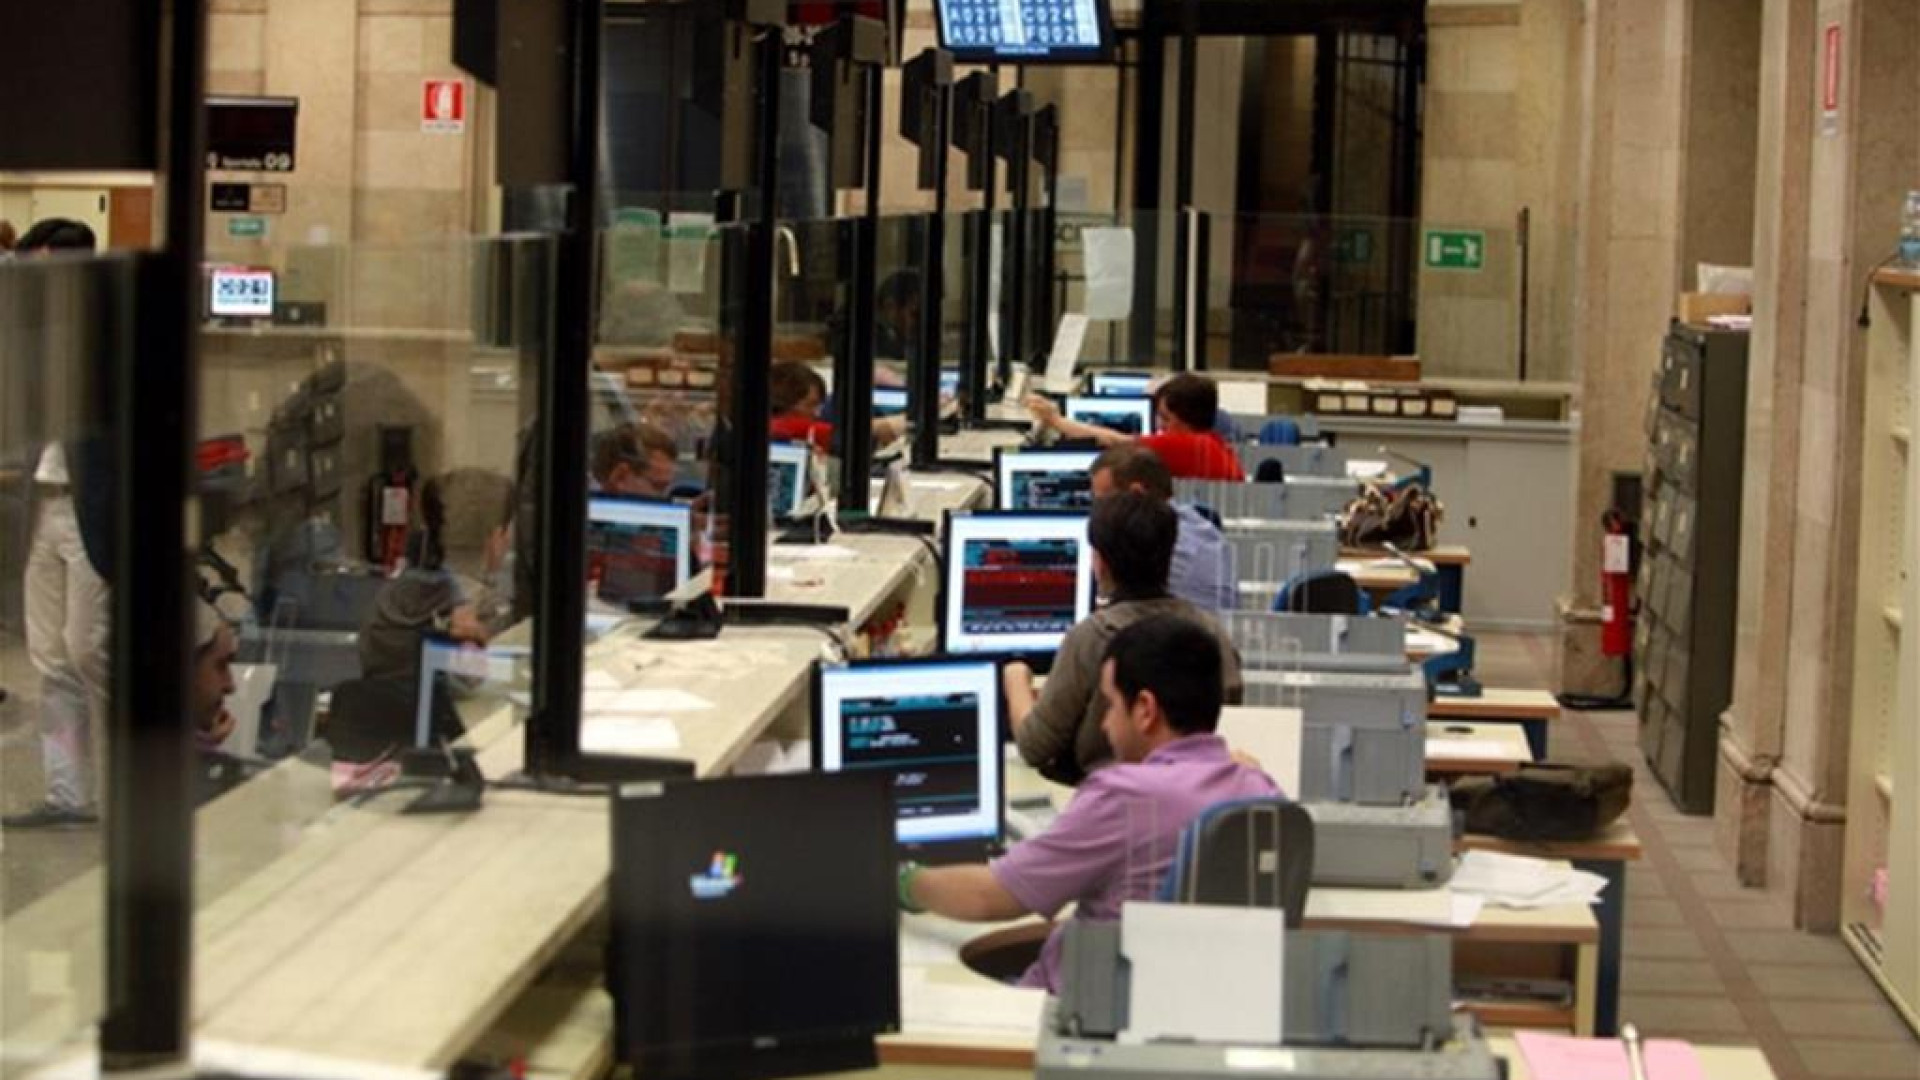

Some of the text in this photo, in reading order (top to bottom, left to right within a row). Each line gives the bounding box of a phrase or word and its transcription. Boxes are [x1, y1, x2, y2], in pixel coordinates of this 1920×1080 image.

[950, 6, 998, 24] A027
[1022, 6, 1074, 24] C024
[264, 152, 291, 171] 09
